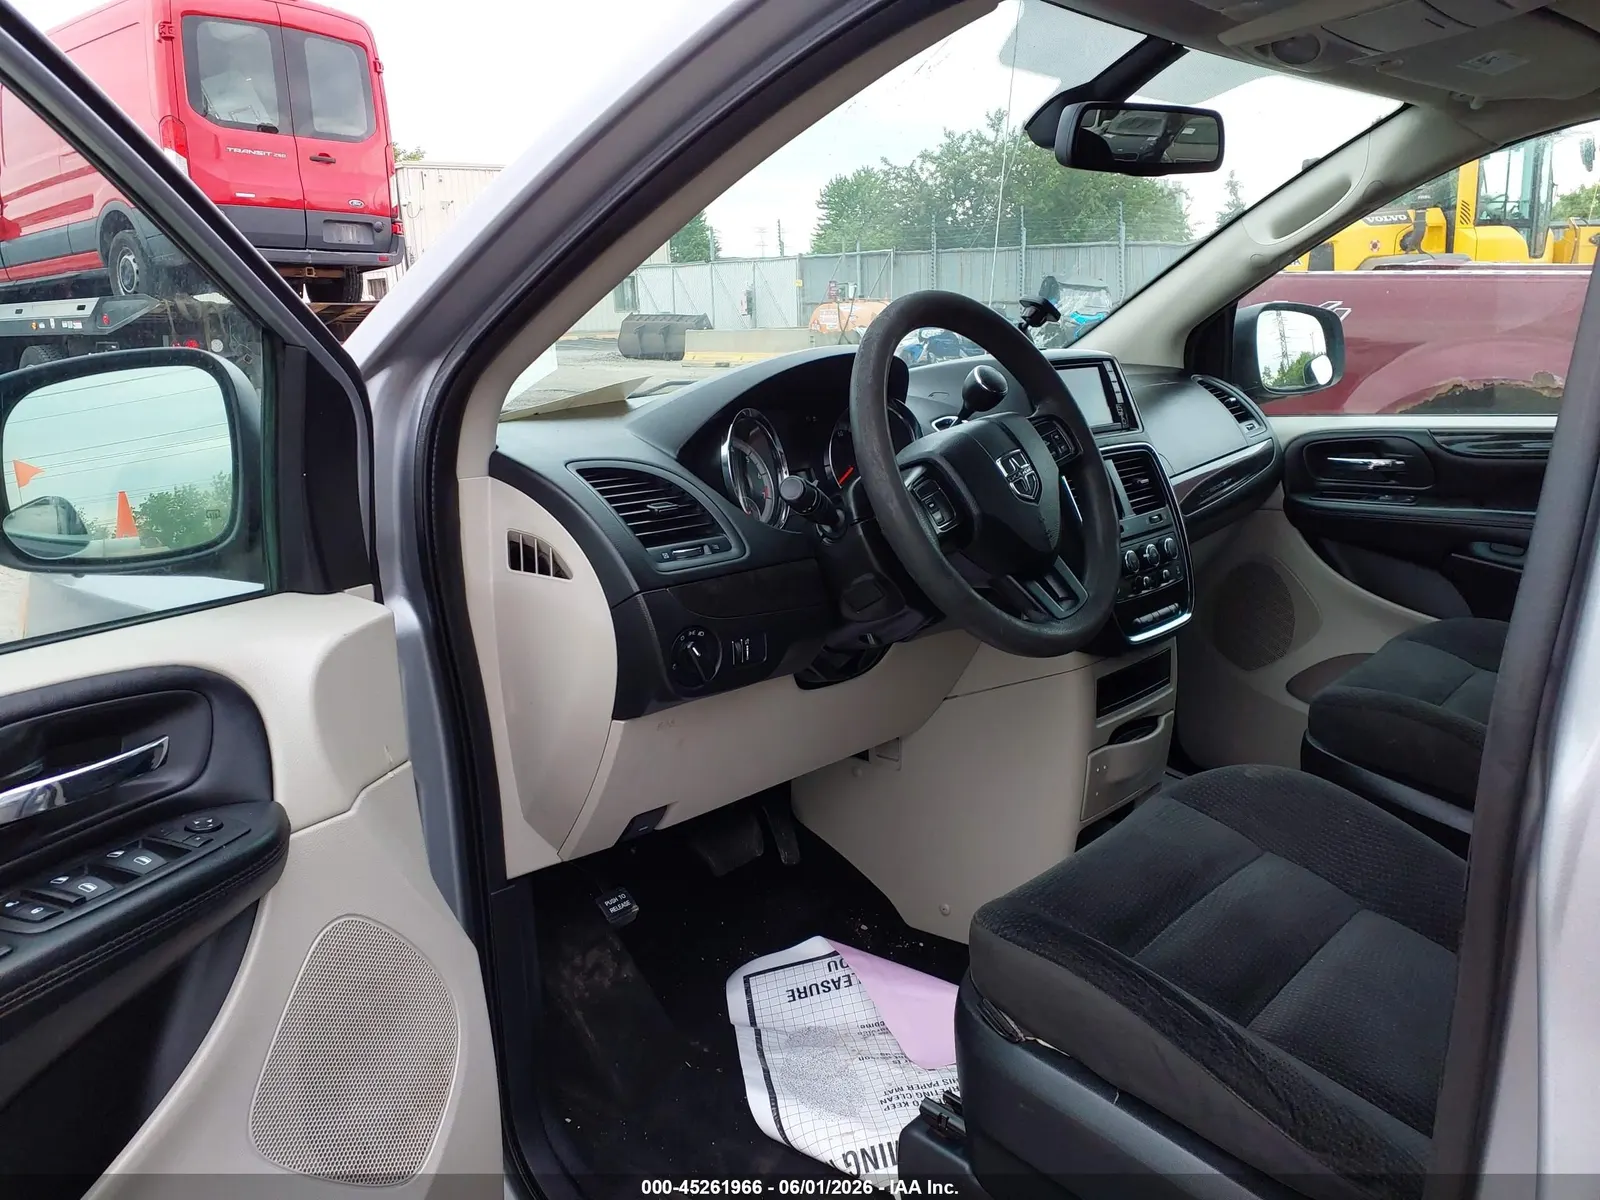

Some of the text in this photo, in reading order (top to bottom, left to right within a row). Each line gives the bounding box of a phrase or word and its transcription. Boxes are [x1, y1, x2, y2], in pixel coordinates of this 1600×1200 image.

[226, 146, 272, 156] TRANSIT
[1365, 214, 1408, 223] VOLVO
[604, 896, 618, 906] PUSH
[609, 900, 631, 913] RELEASE
[906, 1080, 940, 1091] PAPER
[882, 1086, 904, 1096] MAT
[880, 1092, 912, 1105] CLEAN
[884, 1101, 910, 1112] KEEP
